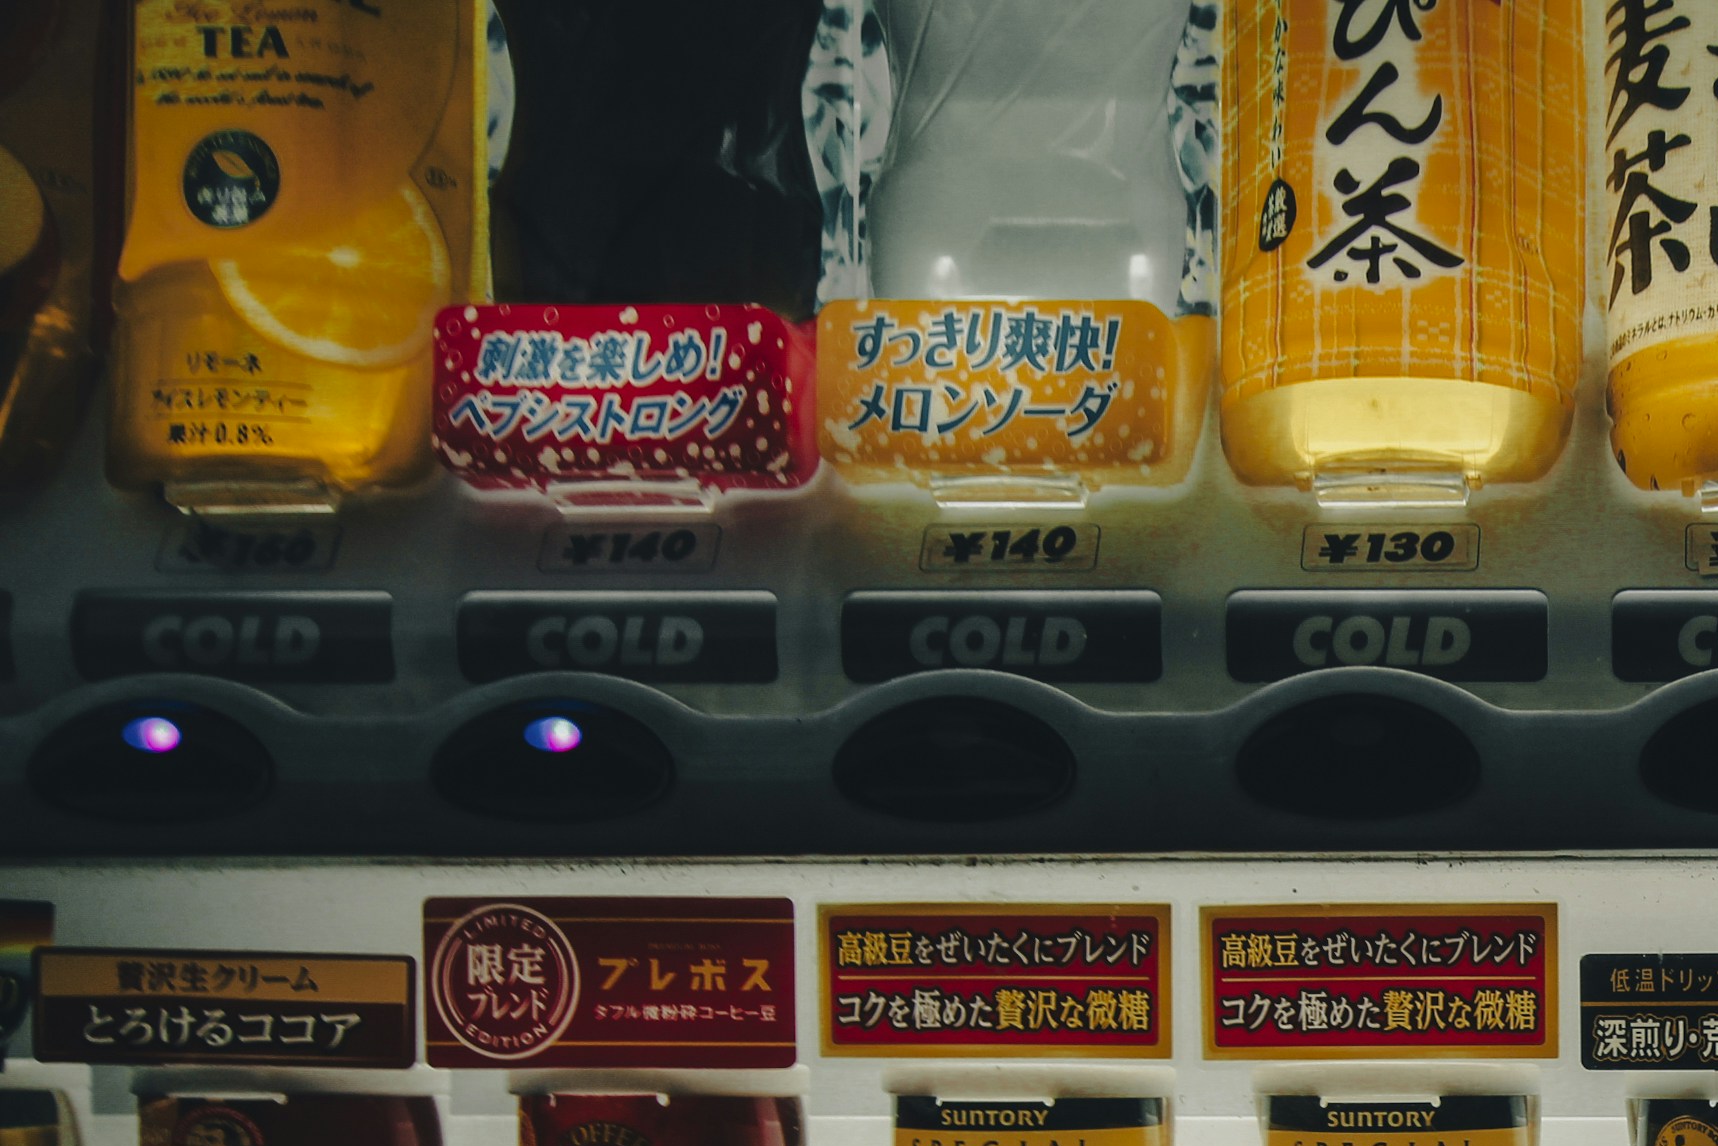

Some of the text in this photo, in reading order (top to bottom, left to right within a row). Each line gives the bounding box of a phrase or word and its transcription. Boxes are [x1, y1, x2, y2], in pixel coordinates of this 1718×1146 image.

[199, 25, 289, 58] TEA
[477, 330, 726, 387] 刺激を楽しめ!
[853, 310, 1120, 373] すっきり爽快!
[453, 389, 744, 443] ペプシストロング
[849, 382, 1118, 438] メロンソーダ
[563, 531, 698, 567] ¥140
[942, 527, 1078, 562] ¥140
[1319, 532, 1455, 564] ¥130
[142, 615, 321, 666] COLD
[526, 614, 704, 666] COLD
[909, 614, 1087, 666] COLD
[1292, 615, 1471, 666] COLD
[466, 943, 546, 986] 限定
[837, 931, 1149, 966] 高級豆をぜいたくにブレンド
[1221, 931, 1536, 968] 高級豆をぜいたくにブレンド
[117, 961, 319, 993] 贅沢生クリーム
[598, 957, 772, 991] プレボス
[467, 986, 549, 1021] ブレンド
[838, 989, 1149, 1031] コクを極めた贅沢な微糖
[1221, 990, 1536, 1031] コクを極めた贅沢な微糖
[83, 1005, 361, 1048] とろけるココア
[940, 1109, 1048, 1126] SUNTORY
[1327, 1110, 1436, 1127] SUNTORY
